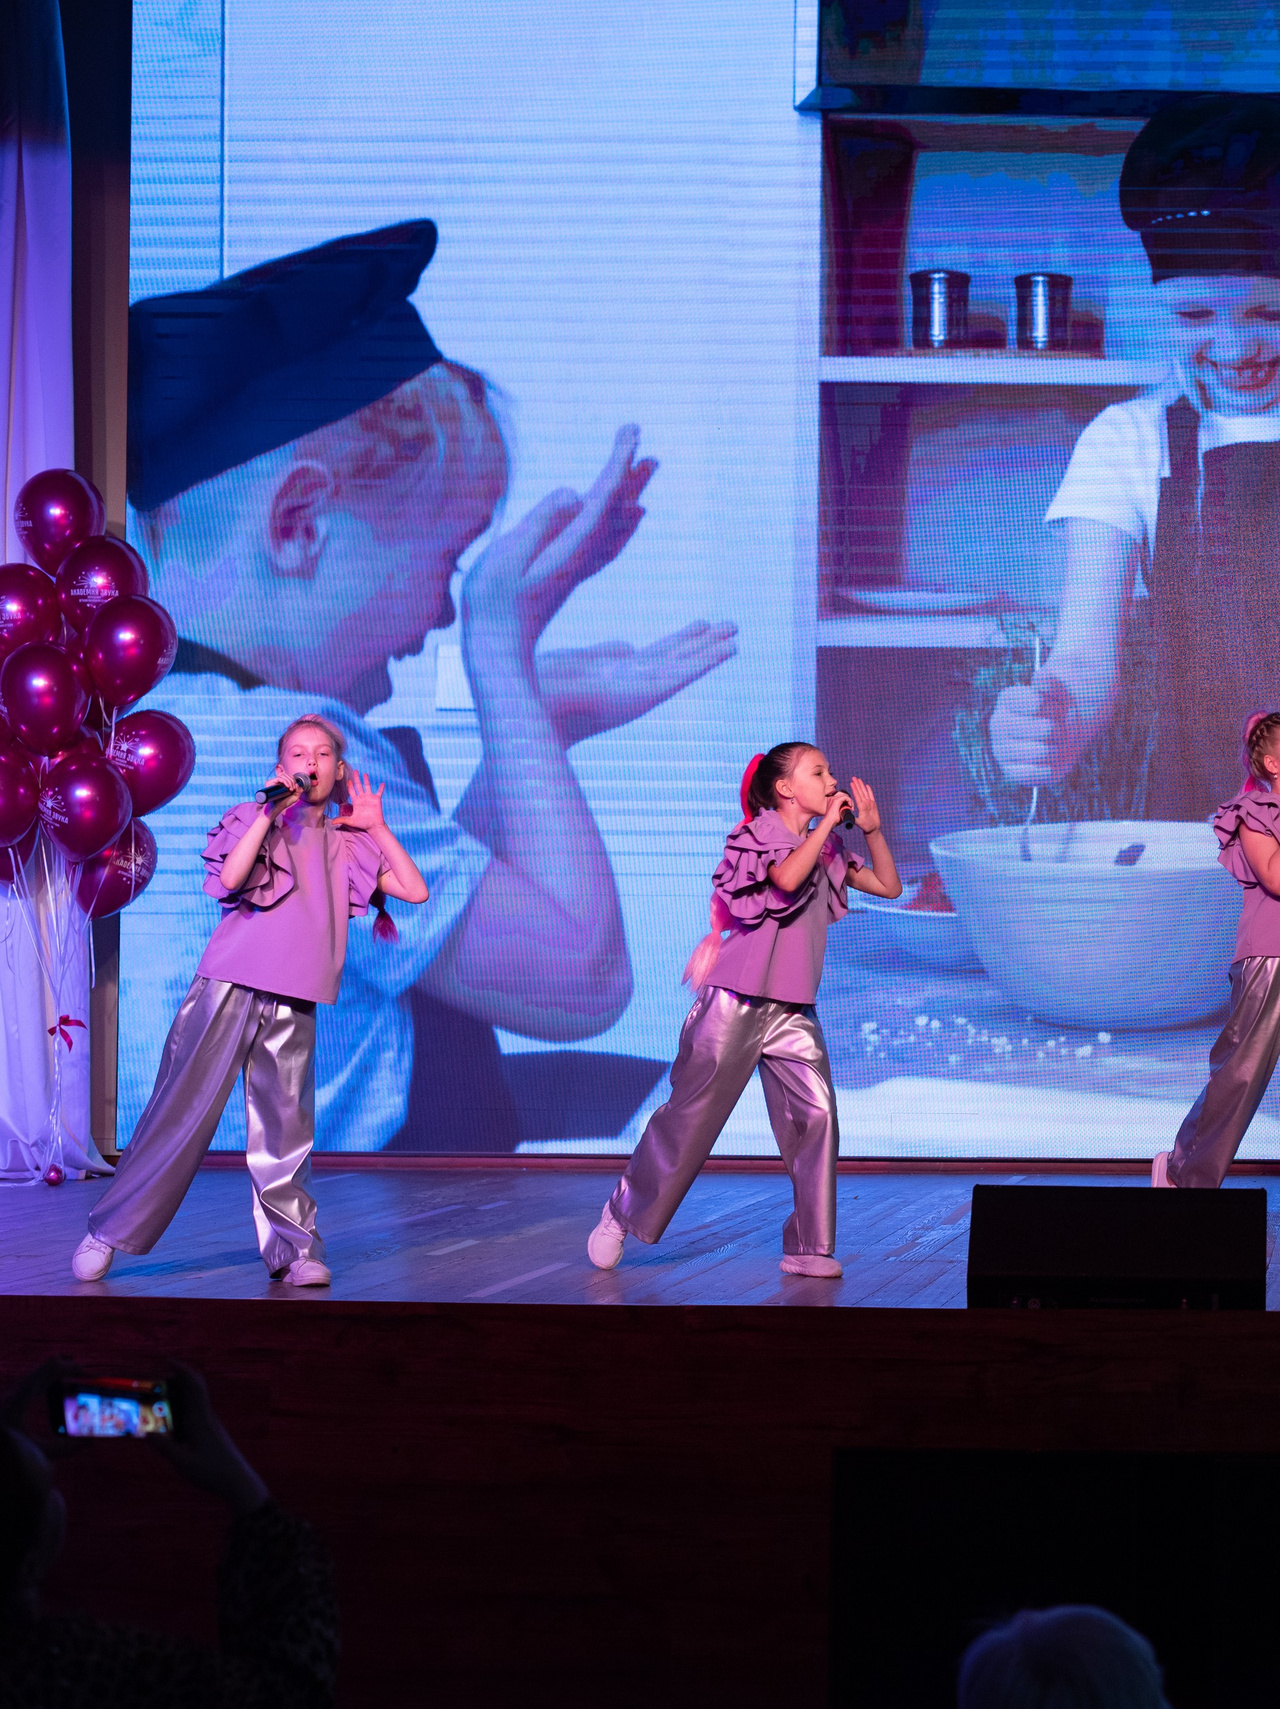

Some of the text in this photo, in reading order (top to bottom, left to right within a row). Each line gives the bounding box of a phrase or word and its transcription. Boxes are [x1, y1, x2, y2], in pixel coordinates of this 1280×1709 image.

[70, 588, 99, 596] АКАДЕМИЯ
[100, 589, 119, 597] ЗВУКА
[2, 612, 21, 620] ЗВУКА
[127, 753, 145, 766] ЗВУКА
[52, 811, 69, 824] ЗВУКА
